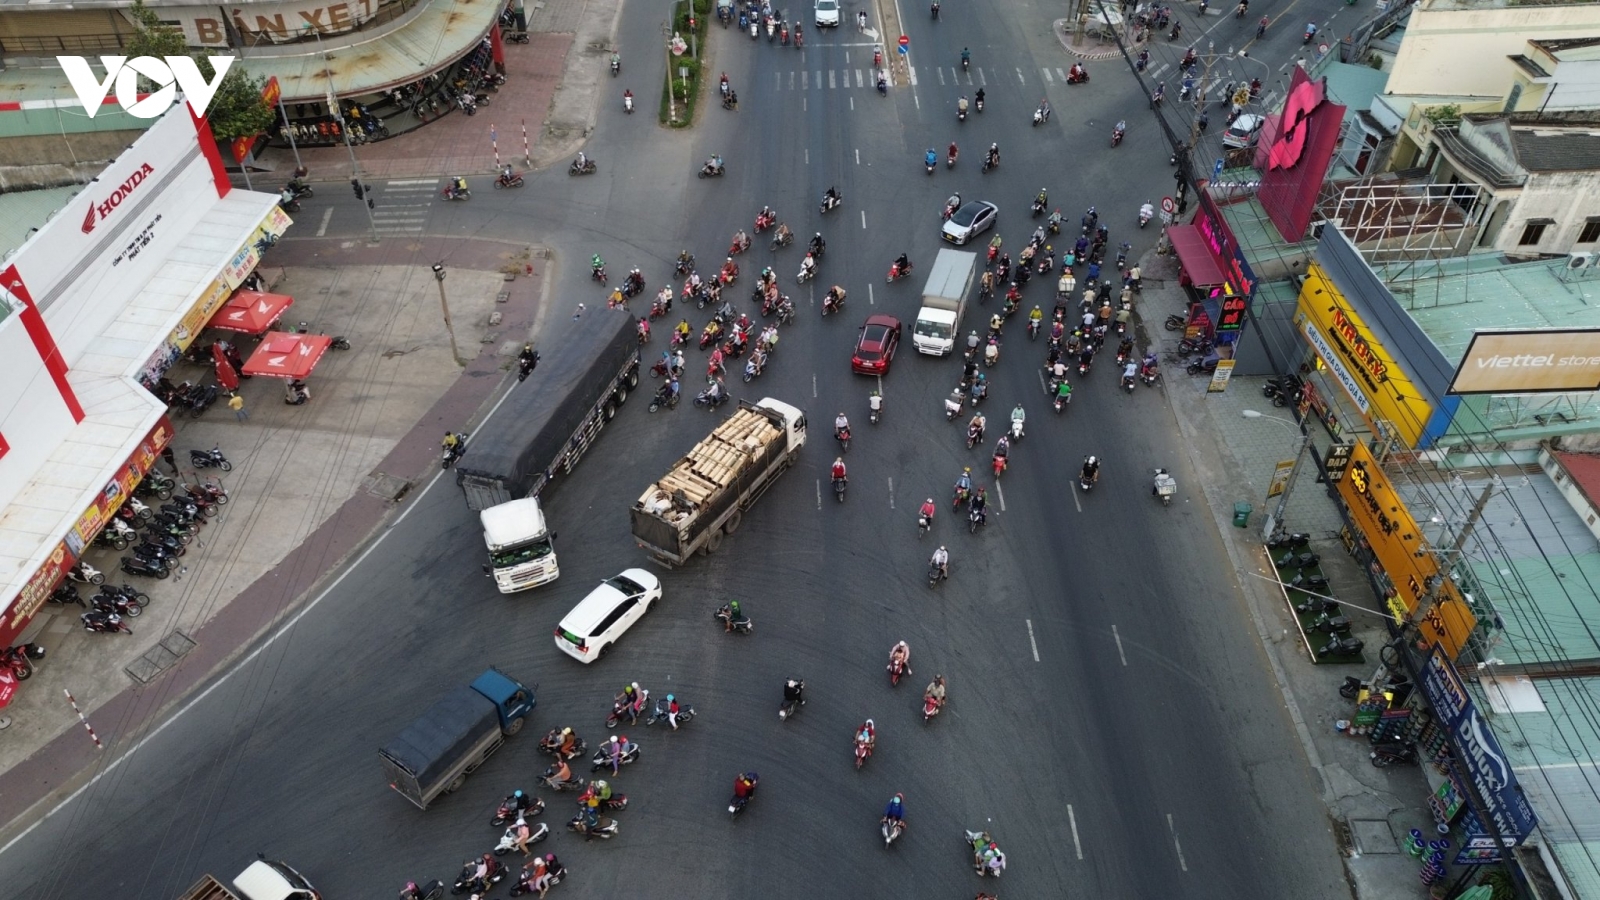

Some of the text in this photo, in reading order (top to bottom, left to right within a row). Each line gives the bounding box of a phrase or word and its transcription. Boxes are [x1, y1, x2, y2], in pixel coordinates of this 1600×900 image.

[194, 9, 289, 44] BÁN
[297, 3, 351, 36] XE
[97, 163, 154, 220] HONDA
[128, 245, 141, 262] PHÁT
[150, 231, 155, 239] 2
[1307, 326, 1320, 344] SIÊU
[1317, 340, 1327, 356] THỊ
[1325, 352, 1335, 366] GIA
[1334, 363, 1350, 385] DỤNG
[1477, 353, 1600, 368] viettel store
[1334, 446, 1349, 456] XE
[1436, 666, 1462, 706] JOTUN
[1459, 718, 1497, 789] Dulux
